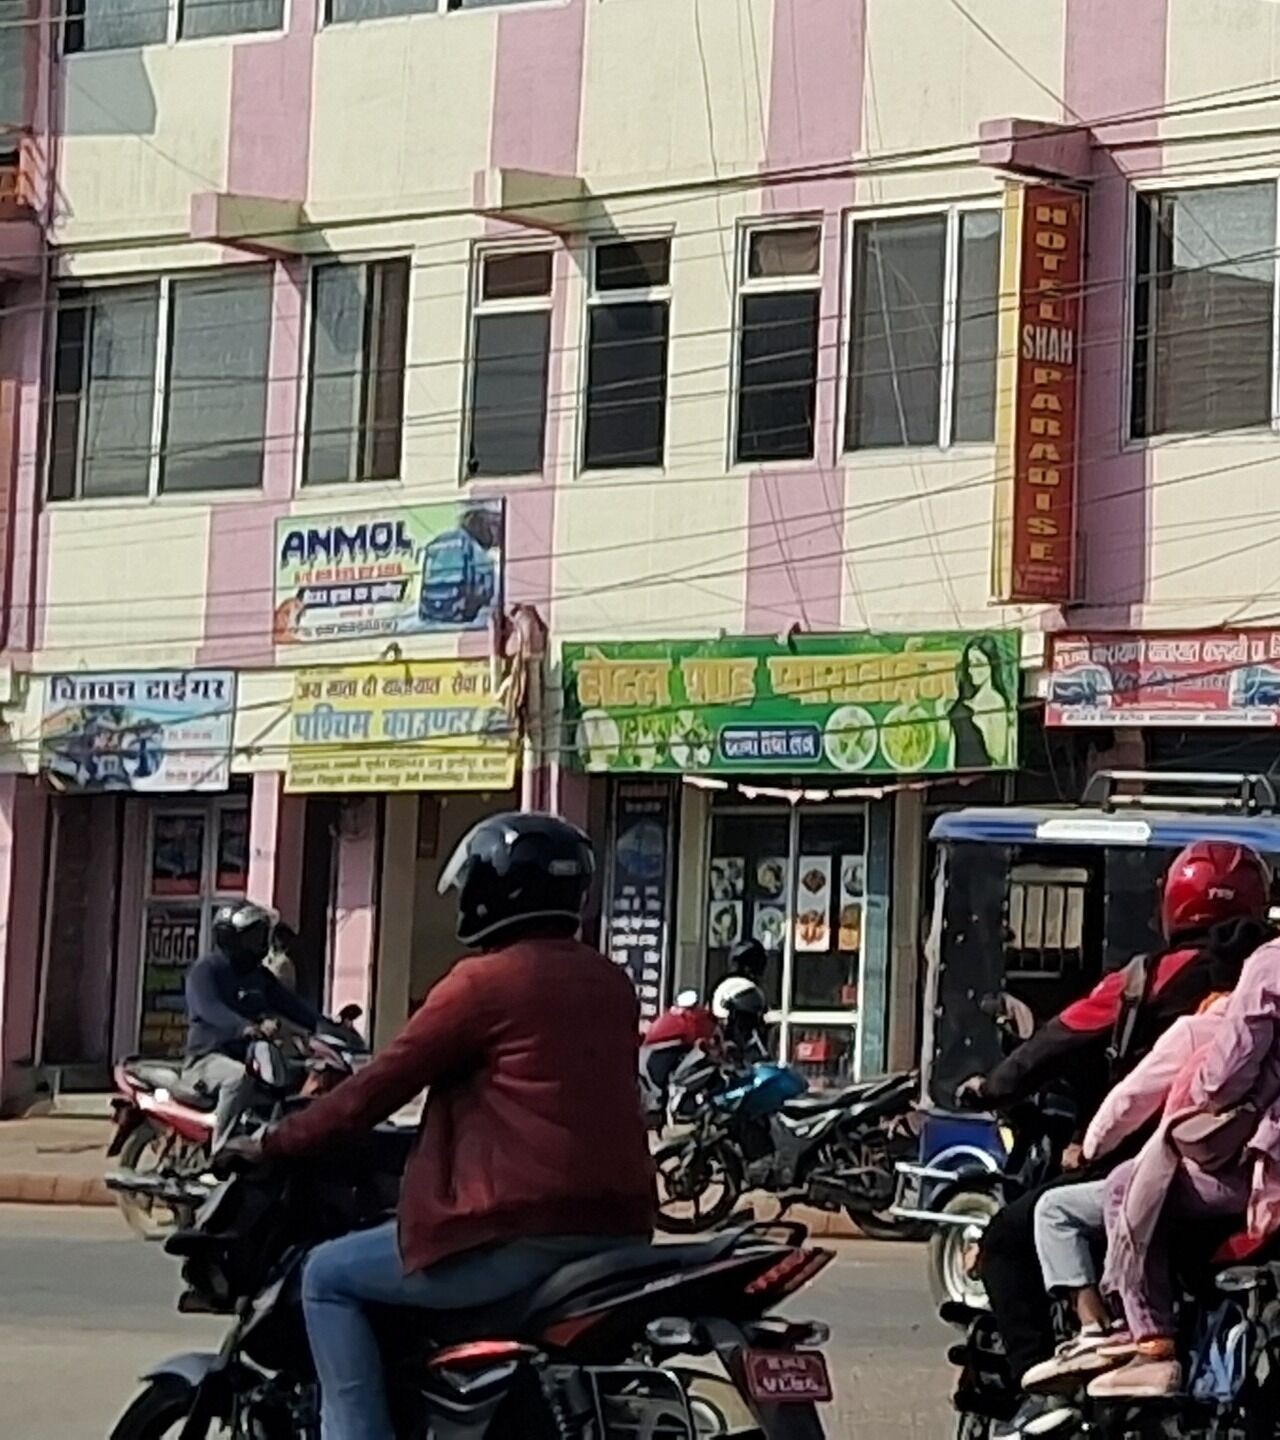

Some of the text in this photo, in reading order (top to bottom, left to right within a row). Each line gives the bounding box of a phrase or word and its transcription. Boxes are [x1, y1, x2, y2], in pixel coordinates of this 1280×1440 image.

[1035, 205, 1067, 323] HOTEL
[1022, 324, 1073, 365] SHAH
[1026, 366, 1064, 561] PARADISE
[282, 521, 413, 568] ANMOL
[572, 646, 672, 707] होटल
